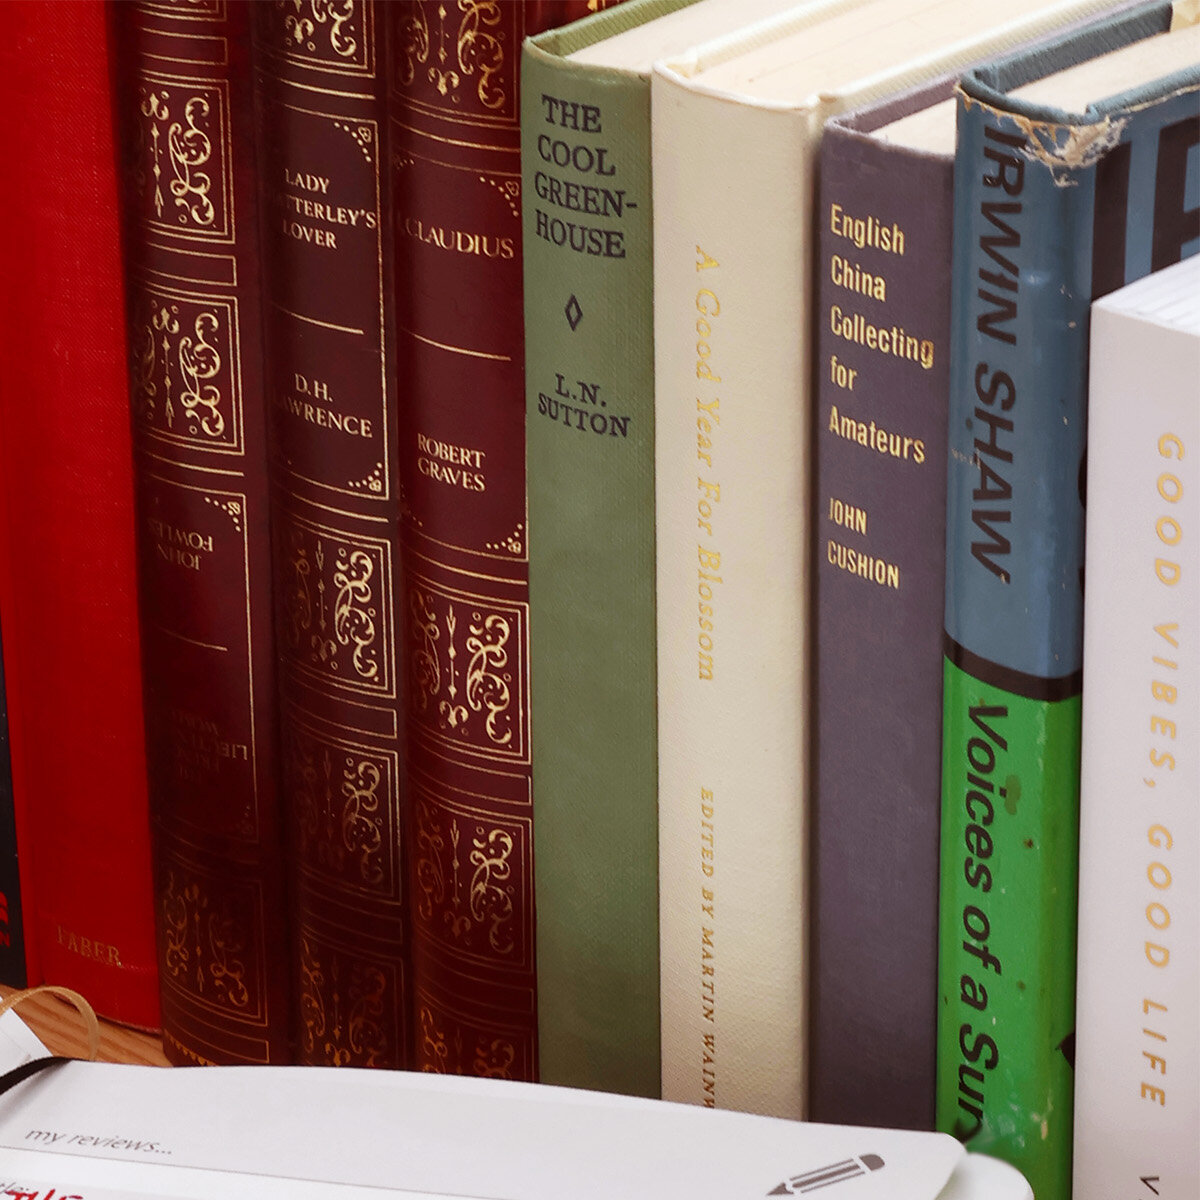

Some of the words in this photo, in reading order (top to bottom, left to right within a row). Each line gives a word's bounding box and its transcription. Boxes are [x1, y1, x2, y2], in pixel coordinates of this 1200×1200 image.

[542, 95, 602, 134] THE
[537, 135, 616, 176] COOL
[285, 168, 330, 194] LADY
[534, 172, 638, 218] GREEN-
[282, 219, 338, 249] LOVER
[405, 218, 515, 259] CLAUDIUS
[535, 212, 626, 259] HOUSE
[830, 203, 905, 256] English
[976, 124, 1027, 346] IRWIN
[696, 245, 721, 273] A
[830, 255, 887, 303] China
[696, 288, 722, 384] Good
[830, 305, 936, 371] Collecting
[295, 373, 334, 402] D.H.
[554, 373, 607, 408] L.N.
[830, 355, 858, 392] for
[284, 396, 373, 438] WRENCE
[538, 393, 630, 438] SUTTON
[697, 396, 721, 468] Year
[829, 405, 926, 465] Amateurs
[417, 433, 486, 469] ROBERT
[418, 457, 486, 492] GRAVES
[971, 362, 1017, 585] SHAW
[698, 476, 722, 536] For
[828, 497, 868, 536] JOHN
[1155, 433, 1185, 587] GOOD
[827, 539, 900, 590] CUSHION
[698, 544, 723, 681] Blossom
[1143, 622, 1179, 788] VIBES,
[965, 706, 1008, 893] Voices
[701, 787, 714, 878] EDITED
[702, 887, 714, 919] BY
[1145, 823, 1174, 969] GOOD
[56, 925, 123, 968] FABER
[962, 905, 1002, 975] of
[702, 926, 715, 1023] MARTIN
[960, 975, 988, 1012] a
[1140, 997, 1168, 1107] LIFE
[25, 1127, 67, 1151] my
[68, 1134, 173, 1157] reviews...
